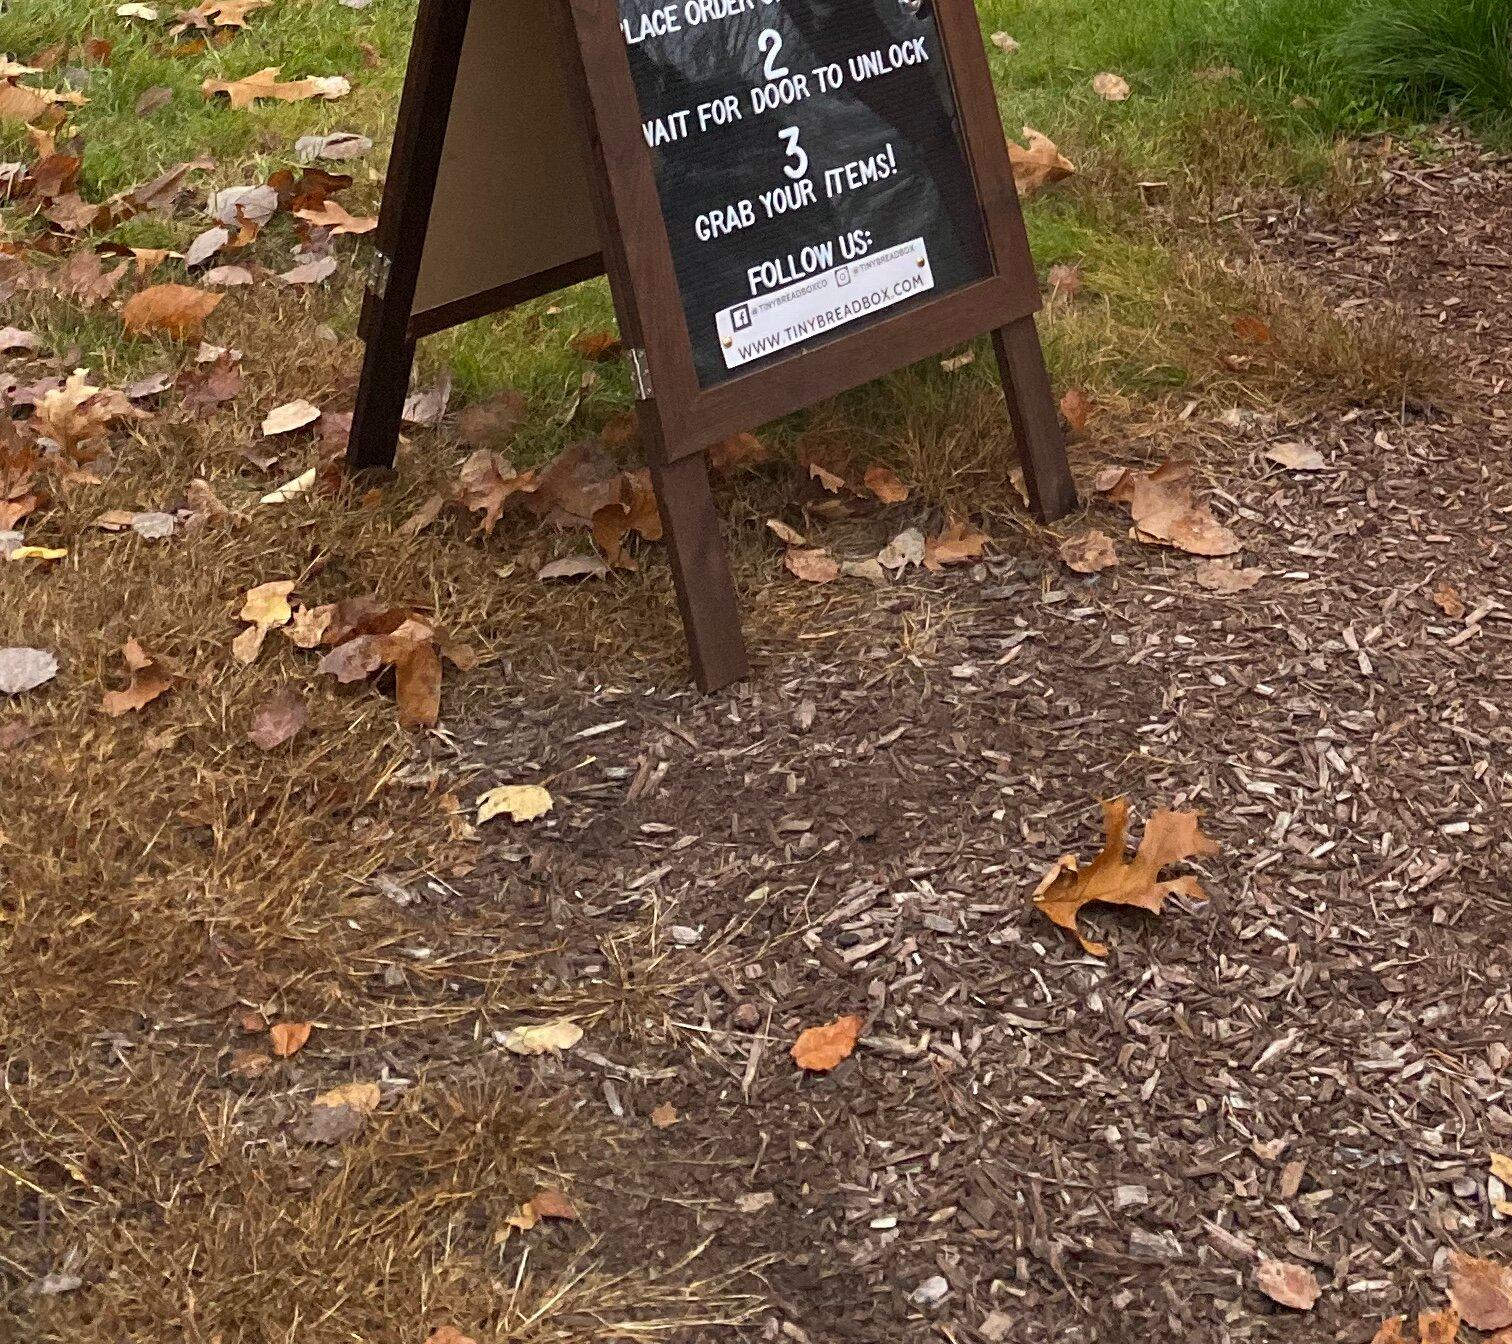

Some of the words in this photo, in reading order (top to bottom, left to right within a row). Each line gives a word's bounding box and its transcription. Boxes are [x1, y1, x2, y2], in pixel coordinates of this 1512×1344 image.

[620, 5, 682, 44] LACE
[757, 28, 789, 81] 2
[696, 95, 742, 132] FOR
[750, 74, 811, 115] DOOR
[811, 63, 843, 93] TO
[848, 36, 929, 83] UNLOCK
[778, 125, 808, 180] 3
[694, 199, 756, 242] GRAB
[758, 178, 817, 218] YOUR
[823, 143, 898, 199] ITEMS!
[747, 240, 834, 296] FOLLOW
[838, 229, 873, 260] US:
[737, 274, 925, 360] WWW.TINYBREADBOX.COM
